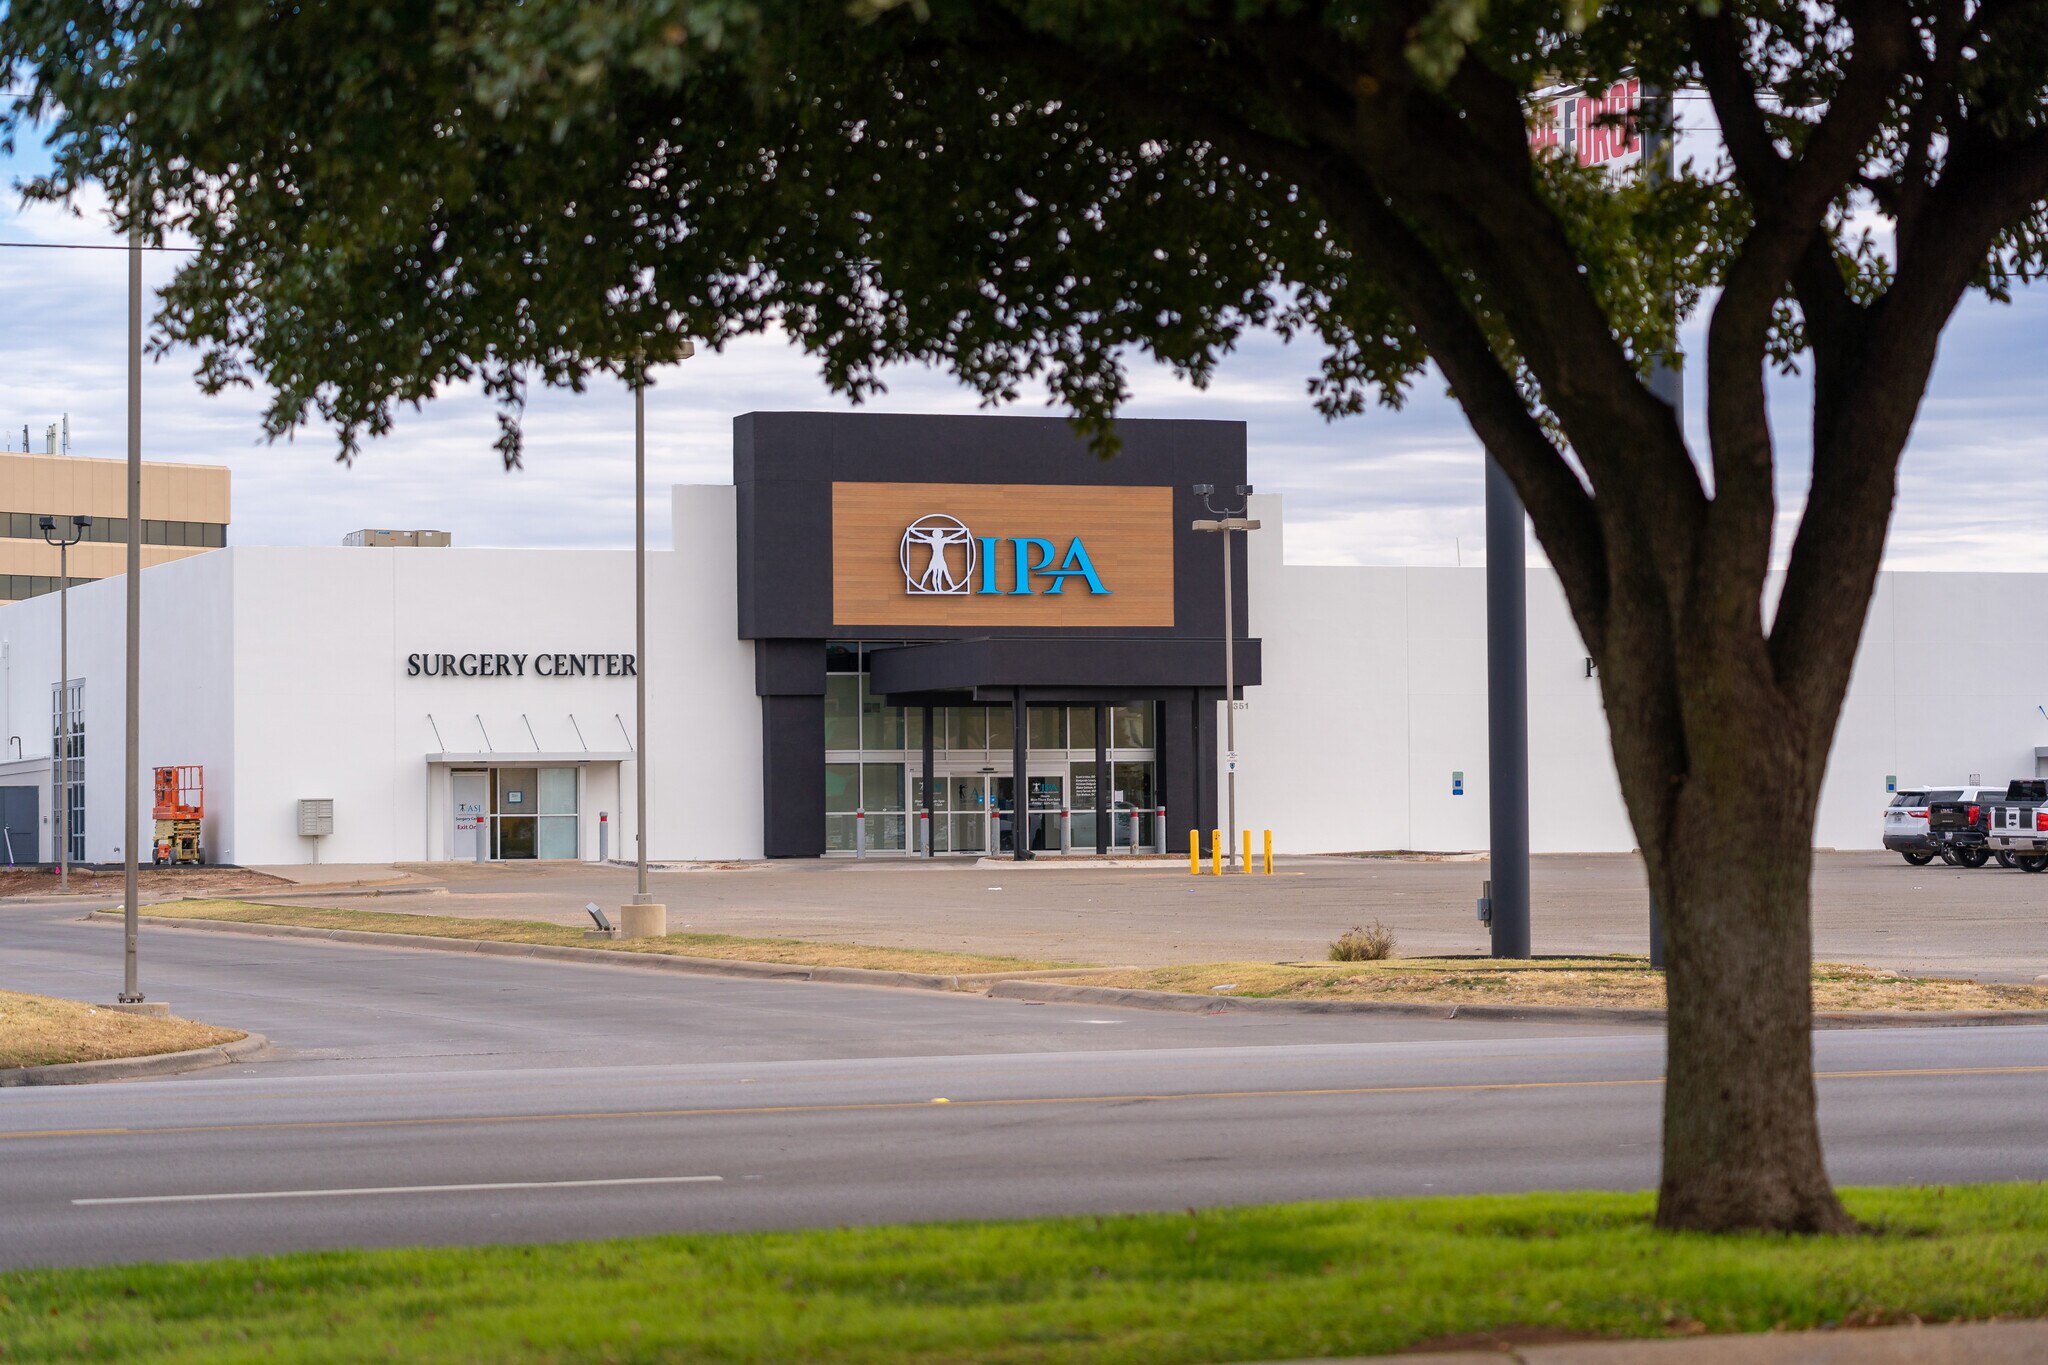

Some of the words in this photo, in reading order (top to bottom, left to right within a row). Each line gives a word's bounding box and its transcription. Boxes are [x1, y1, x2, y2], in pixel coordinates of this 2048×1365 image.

[976, 536, 1113, 594] IPA
[407, 653, 528, 676] SURGERY
[535, 653, 637, 676] CENTER
